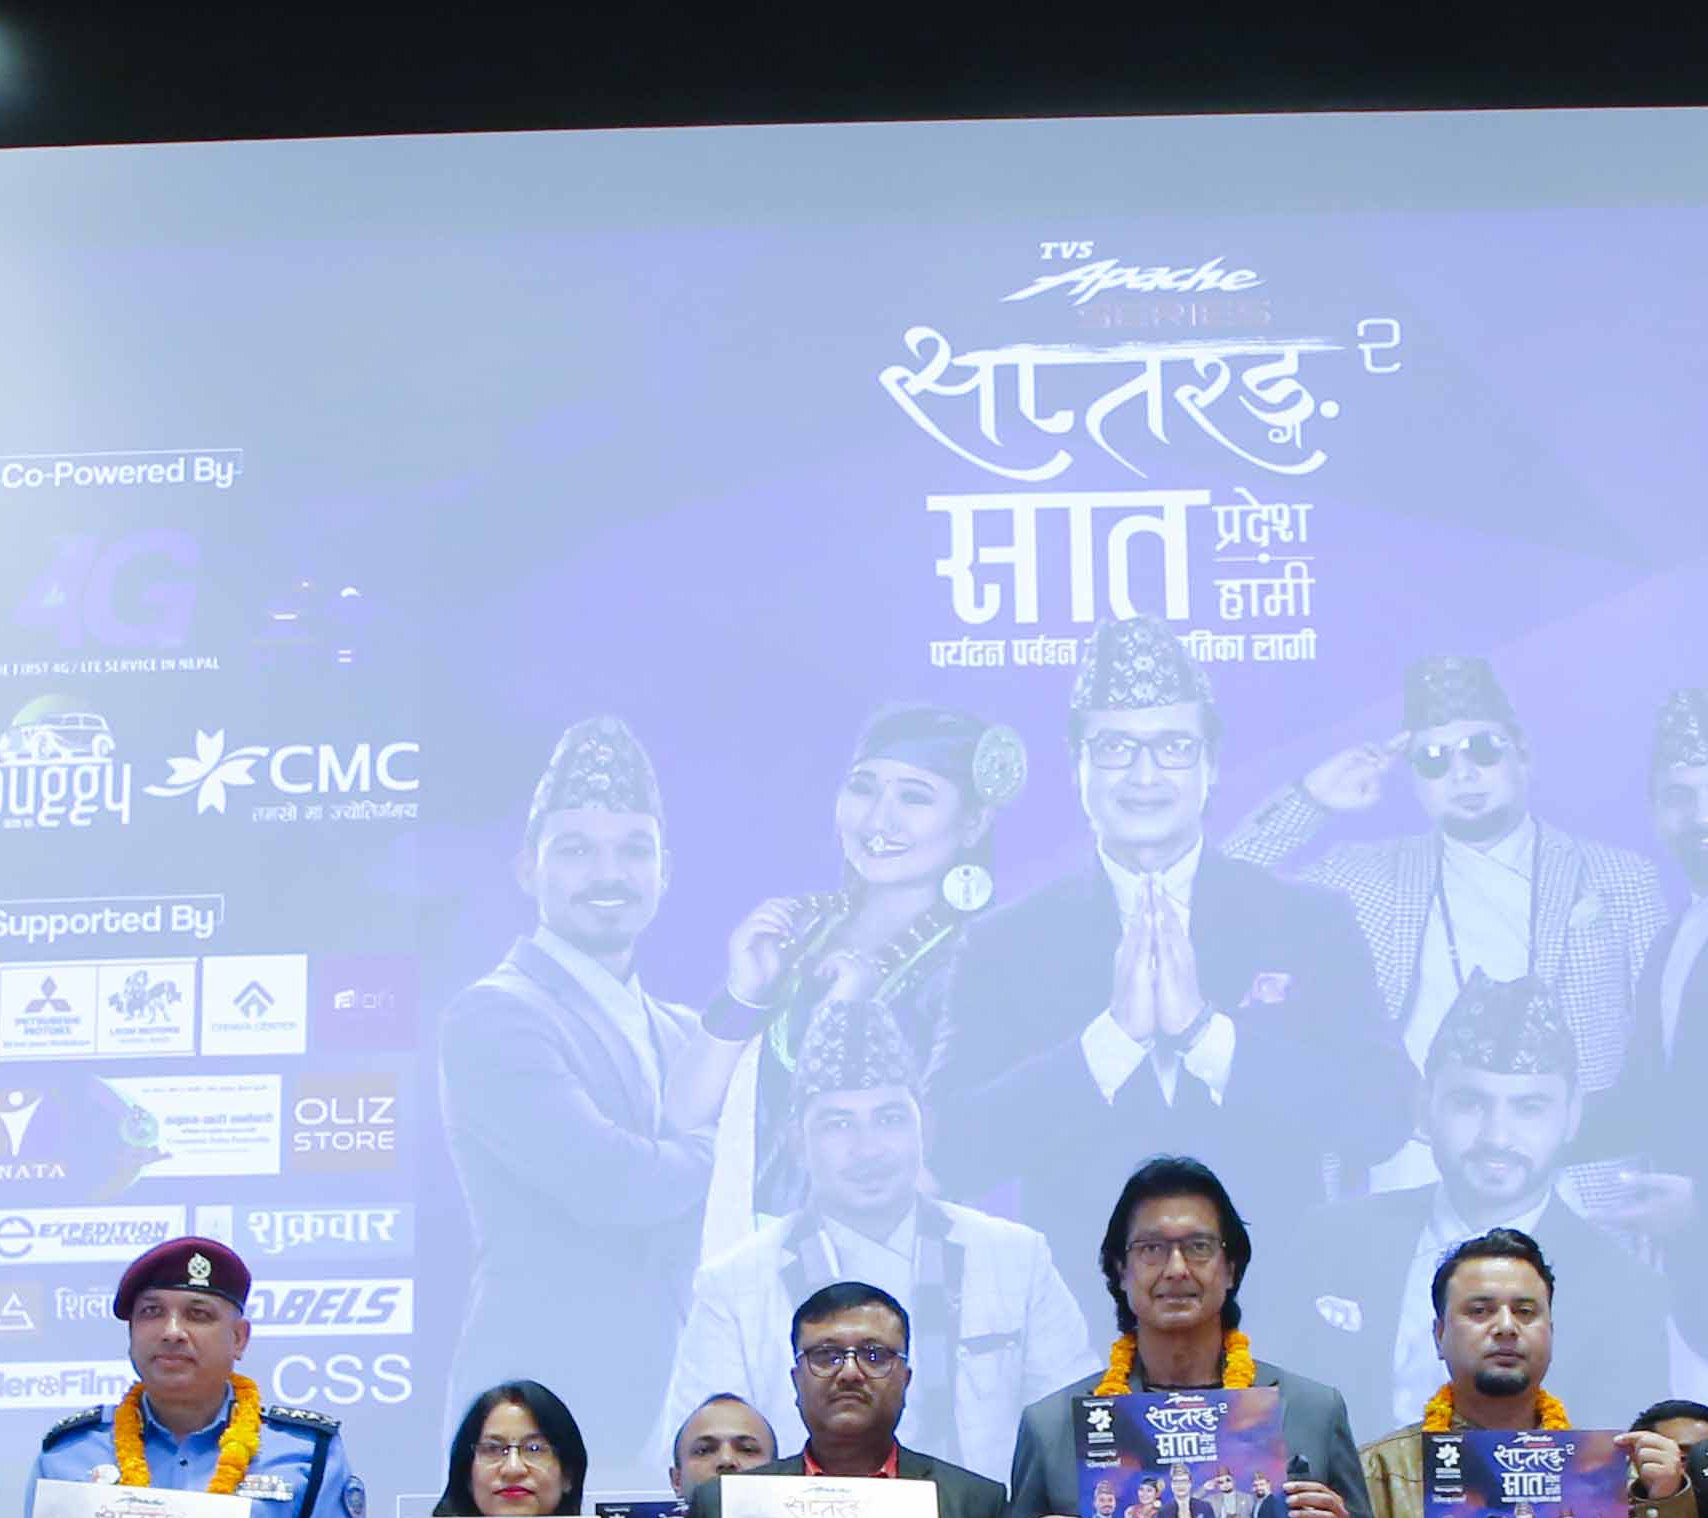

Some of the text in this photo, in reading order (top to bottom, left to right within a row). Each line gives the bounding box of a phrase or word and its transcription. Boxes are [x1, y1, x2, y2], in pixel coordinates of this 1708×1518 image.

[1041, 242, 1094, 260] TVS
[999, 256, 1268, 305] Apache
[1, 454, 236, 489] Co-Powered By
[1212, 487, 1315, 551] प्रदेश
[926, 489, 1211, 624] सात
[13, 530, 202, 650] 4G
[1213, 561, 1316, 621] हामी
[1252, 628, 1318, 662] लागी
[105, 658, 158, 674] SERVICE
[160, 658, 177, 673] IN
[180, 656, 221, 672] NEPAL
[269, 741, 421, 794] CMC
[171, 904, 215, 937] By
[293, 1097, 395, 1125] OLIZ
[292, 1131, 395, 1151] STORE
[38, 1220, 170, 1239] EXPEDITION
[247, 1208, 396, 1247] शुक्रवार
[272, 1354, 413, 1404] CSS
[1155, 1432, 1200, 1457] सात
[1501, 1473, 1546, 1496] सात
